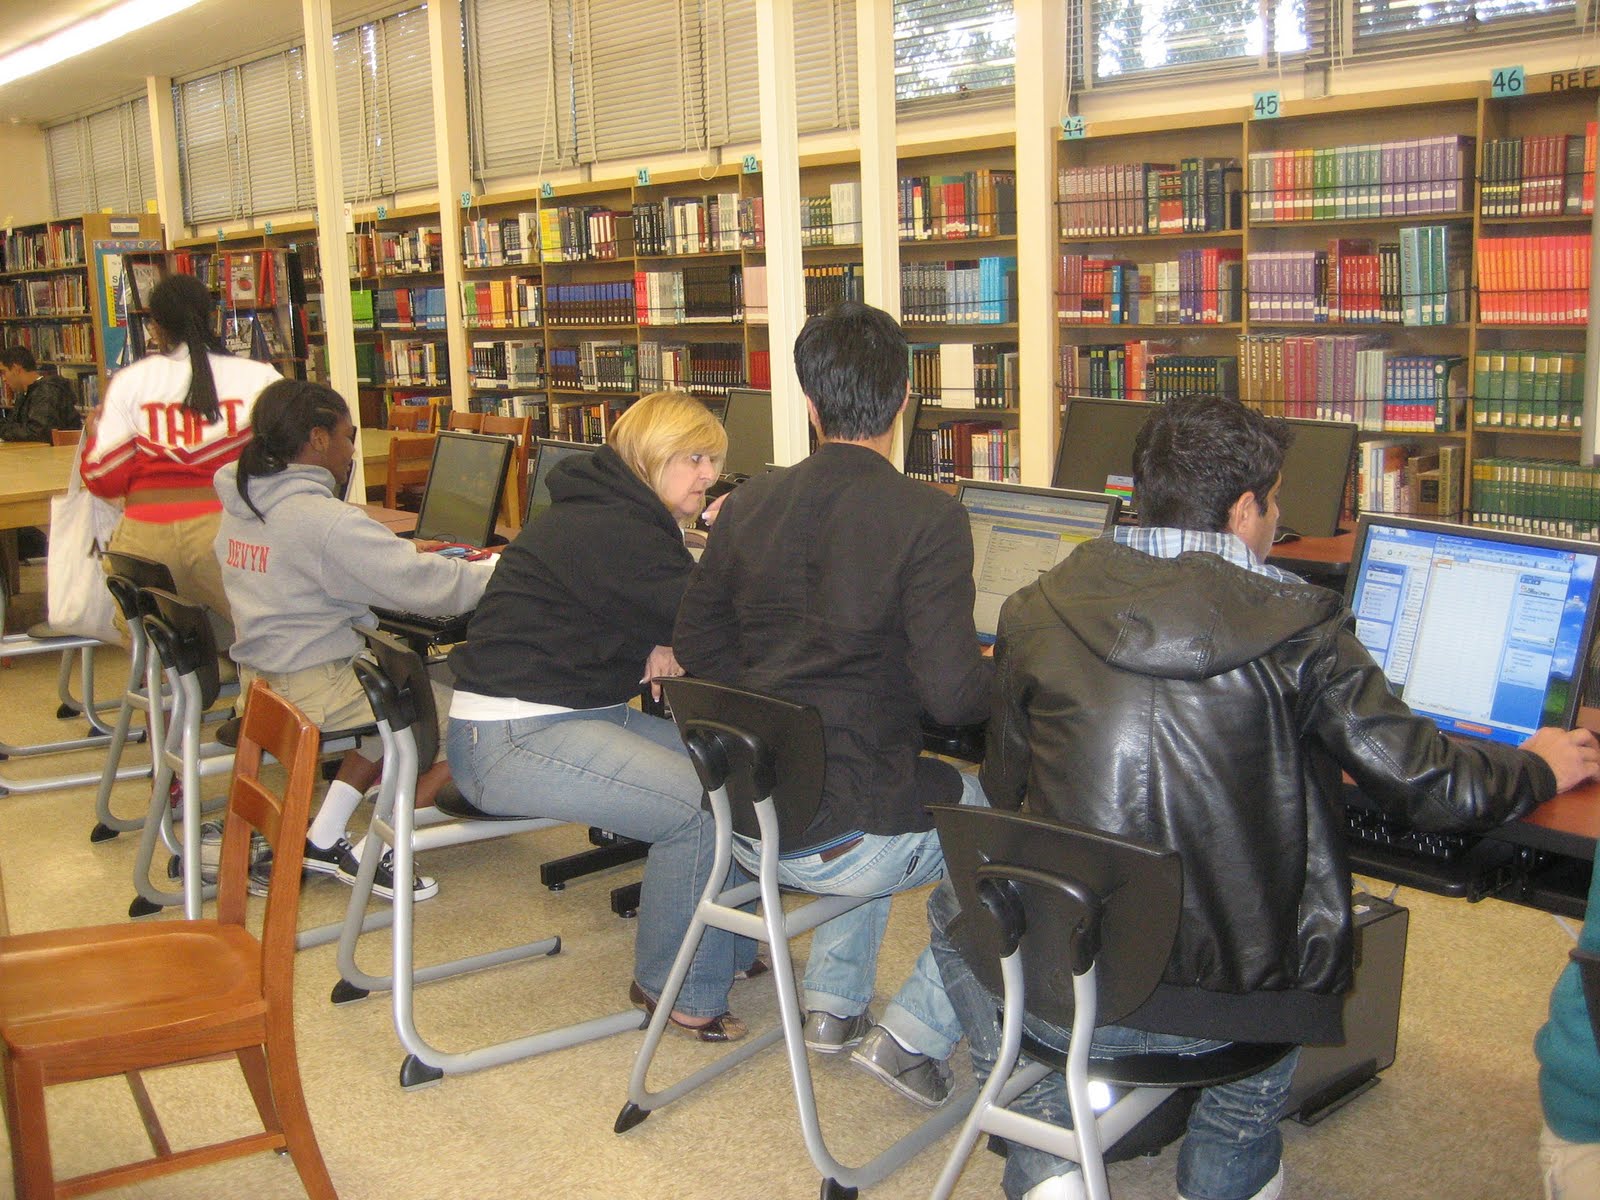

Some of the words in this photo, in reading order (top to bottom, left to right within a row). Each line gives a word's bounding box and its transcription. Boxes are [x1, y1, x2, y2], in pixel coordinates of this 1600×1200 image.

[1492, 69, 1521, 92] 46
[1550, 68, 1597, 92] REF
[1254, 95, 1278, 115] 45
[1063, 119, 1084, 137] 44
[743, 156, 757, 171] 42
[638, 169, 648, 183] 41
[542, 183, 552, 196] 40
[461, 192, 471, 206] 39
[226, 538, 271, 574] DEVYN
